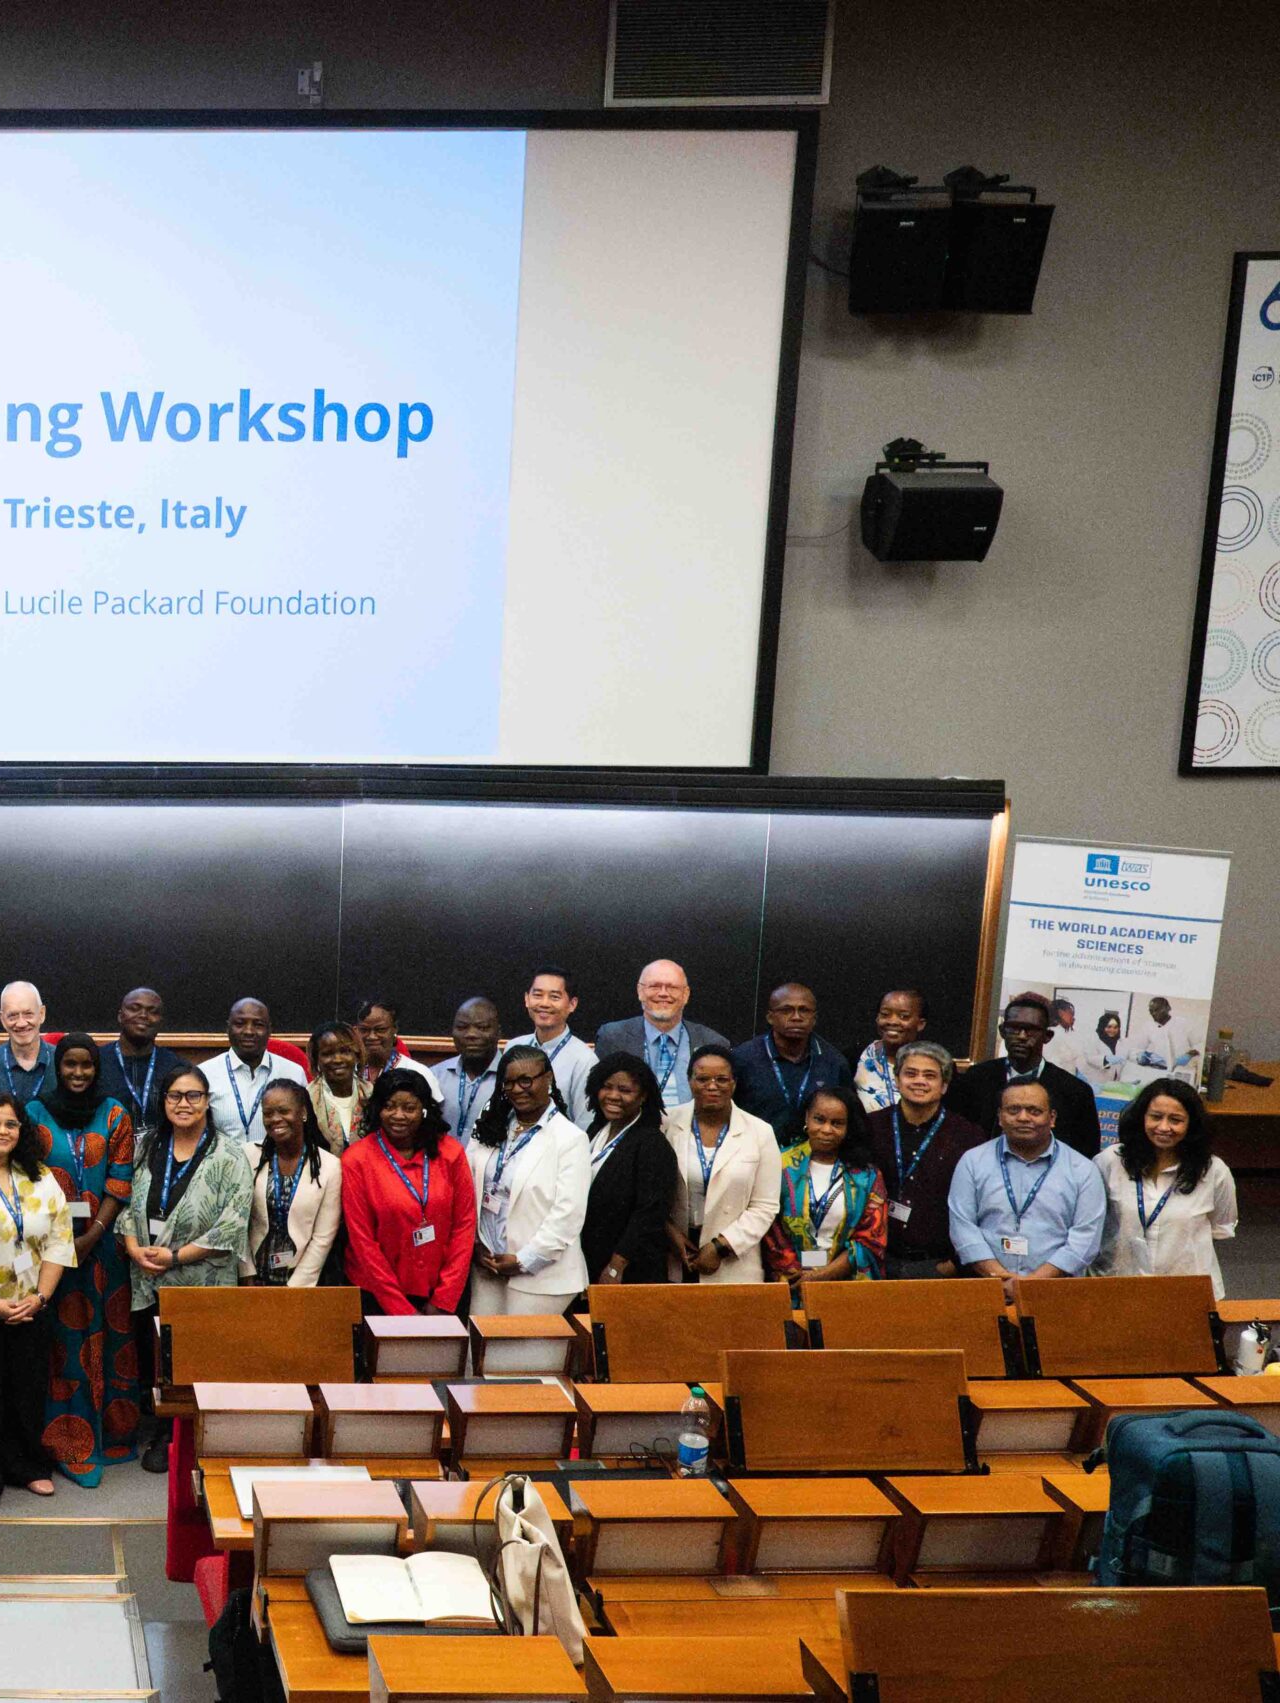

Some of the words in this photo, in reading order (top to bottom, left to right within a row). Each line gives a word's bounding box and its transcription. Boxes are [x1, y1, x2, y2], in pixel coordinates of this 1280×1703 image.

[100, 388, 434, 459] Workshop
[3, 497, 146, 534] Trieste,
[161, 496, 247, 538] Italy
[5, 589, 83, 615] Lucile
[94, 589, 204, 615] Packard
[216, 590, 377, 615] Foundation
[1085, 877, 1151, 891] unesco
[1029, 919, 1055, 930] THE
[1058, 921, 1107, 935] WORLD
[1109, 926, 1177, 943] ACADEMY
[1179, 933, 1198, 944] OF
[1077, 939, 1144, 955] SCIENCES
